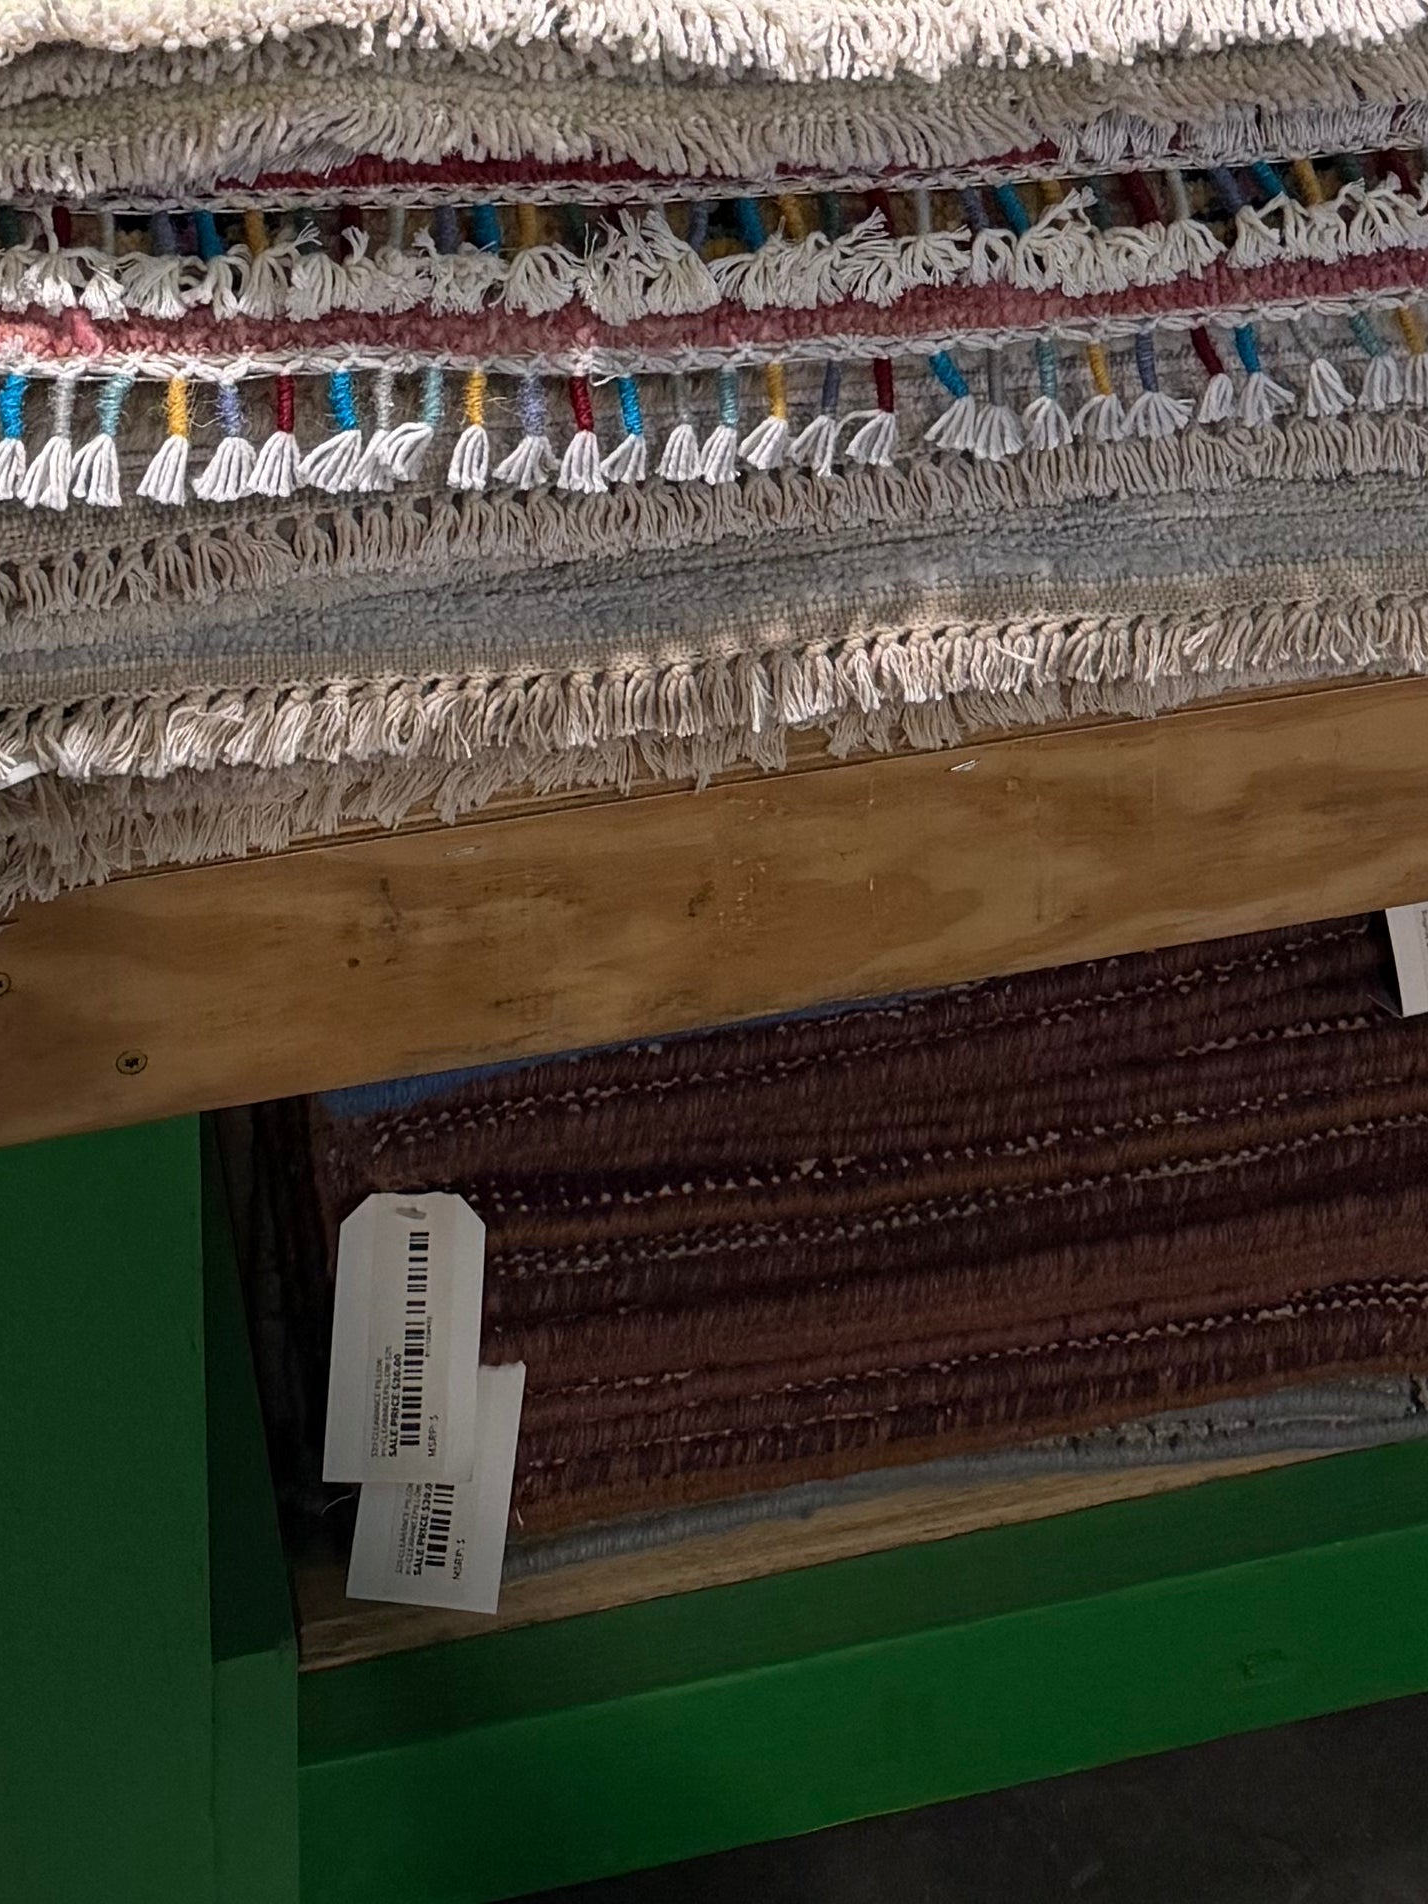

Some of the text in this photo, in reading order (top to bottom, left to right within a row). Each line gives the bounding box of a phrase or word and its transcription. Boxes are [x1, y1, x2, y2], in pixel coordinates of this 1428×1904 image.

[388, 1394, 400, 1427] PRICE
[387, 1429, 398, 1457] SALE
[410, 1482, 434, 1576] SALE PRICE $20.0
